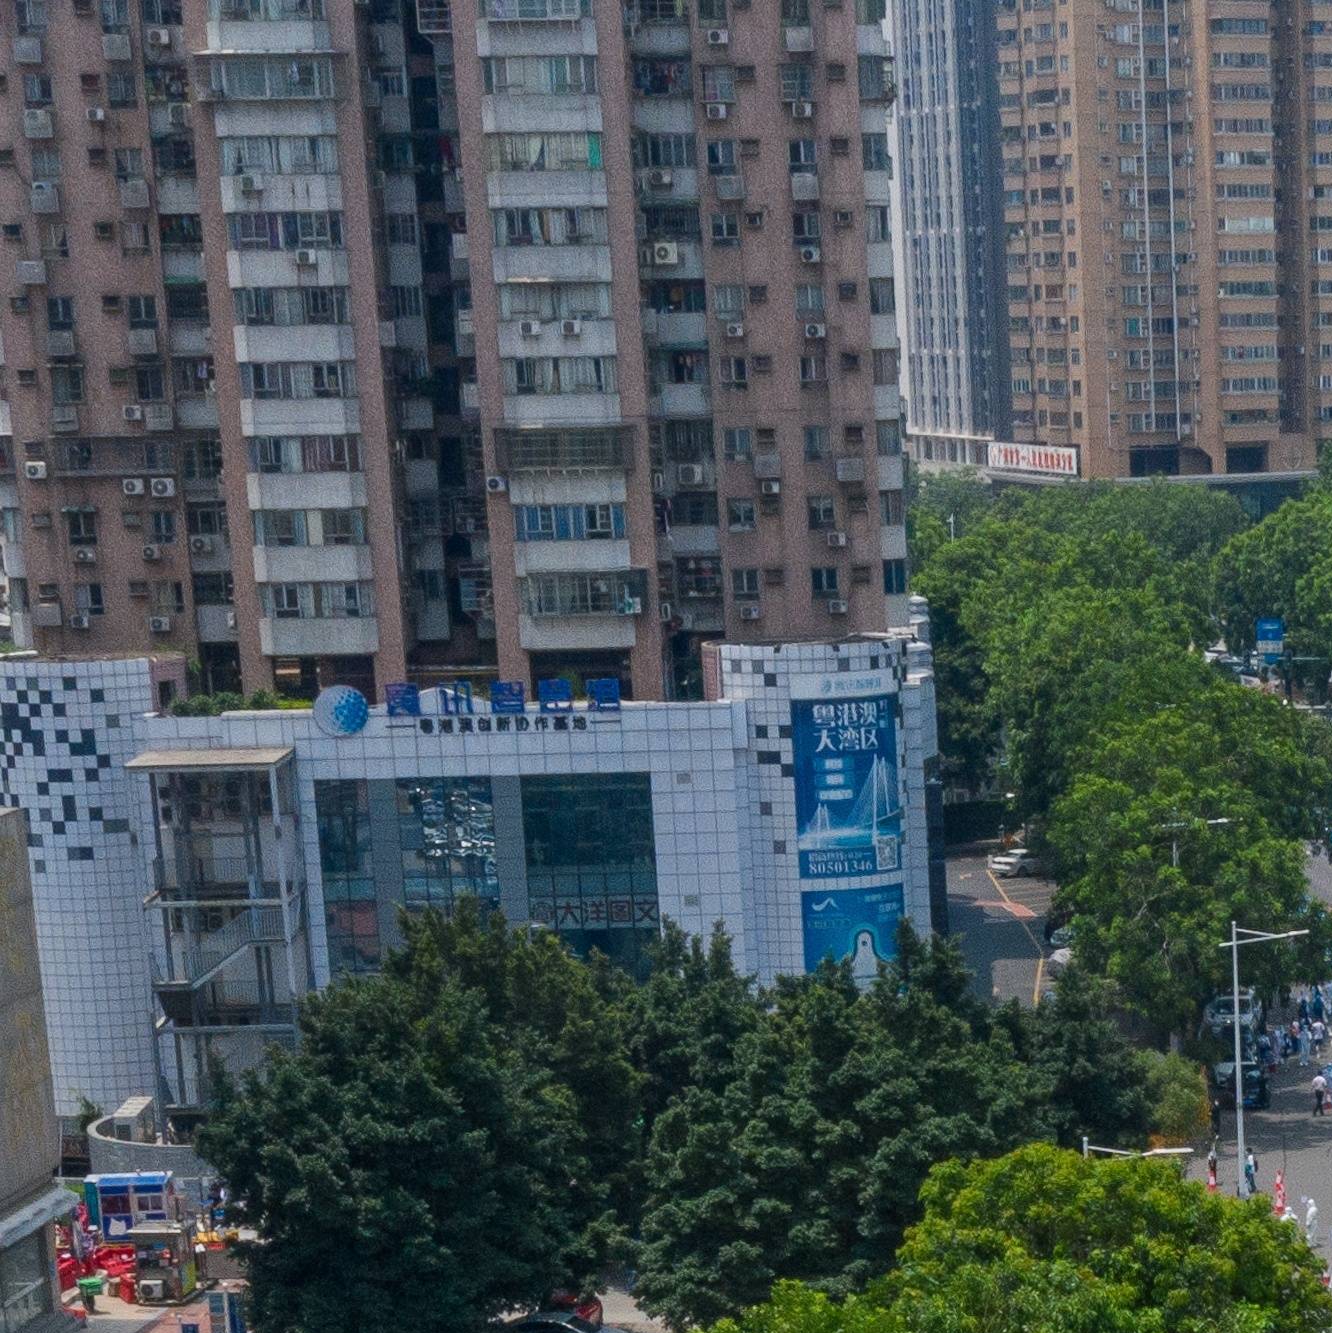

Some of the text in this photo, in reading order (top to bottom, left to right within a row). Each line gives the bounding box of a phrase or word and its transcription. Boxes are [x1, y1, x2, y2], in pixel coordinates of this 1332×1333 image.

[419, 715, 588, 734] 粤港澳创新协作基地
[812, 702, 877, 727] 粤港澳
[813, 727, 879, 752] 大湾区
[555, 900, 659, 923] 大洋图文
